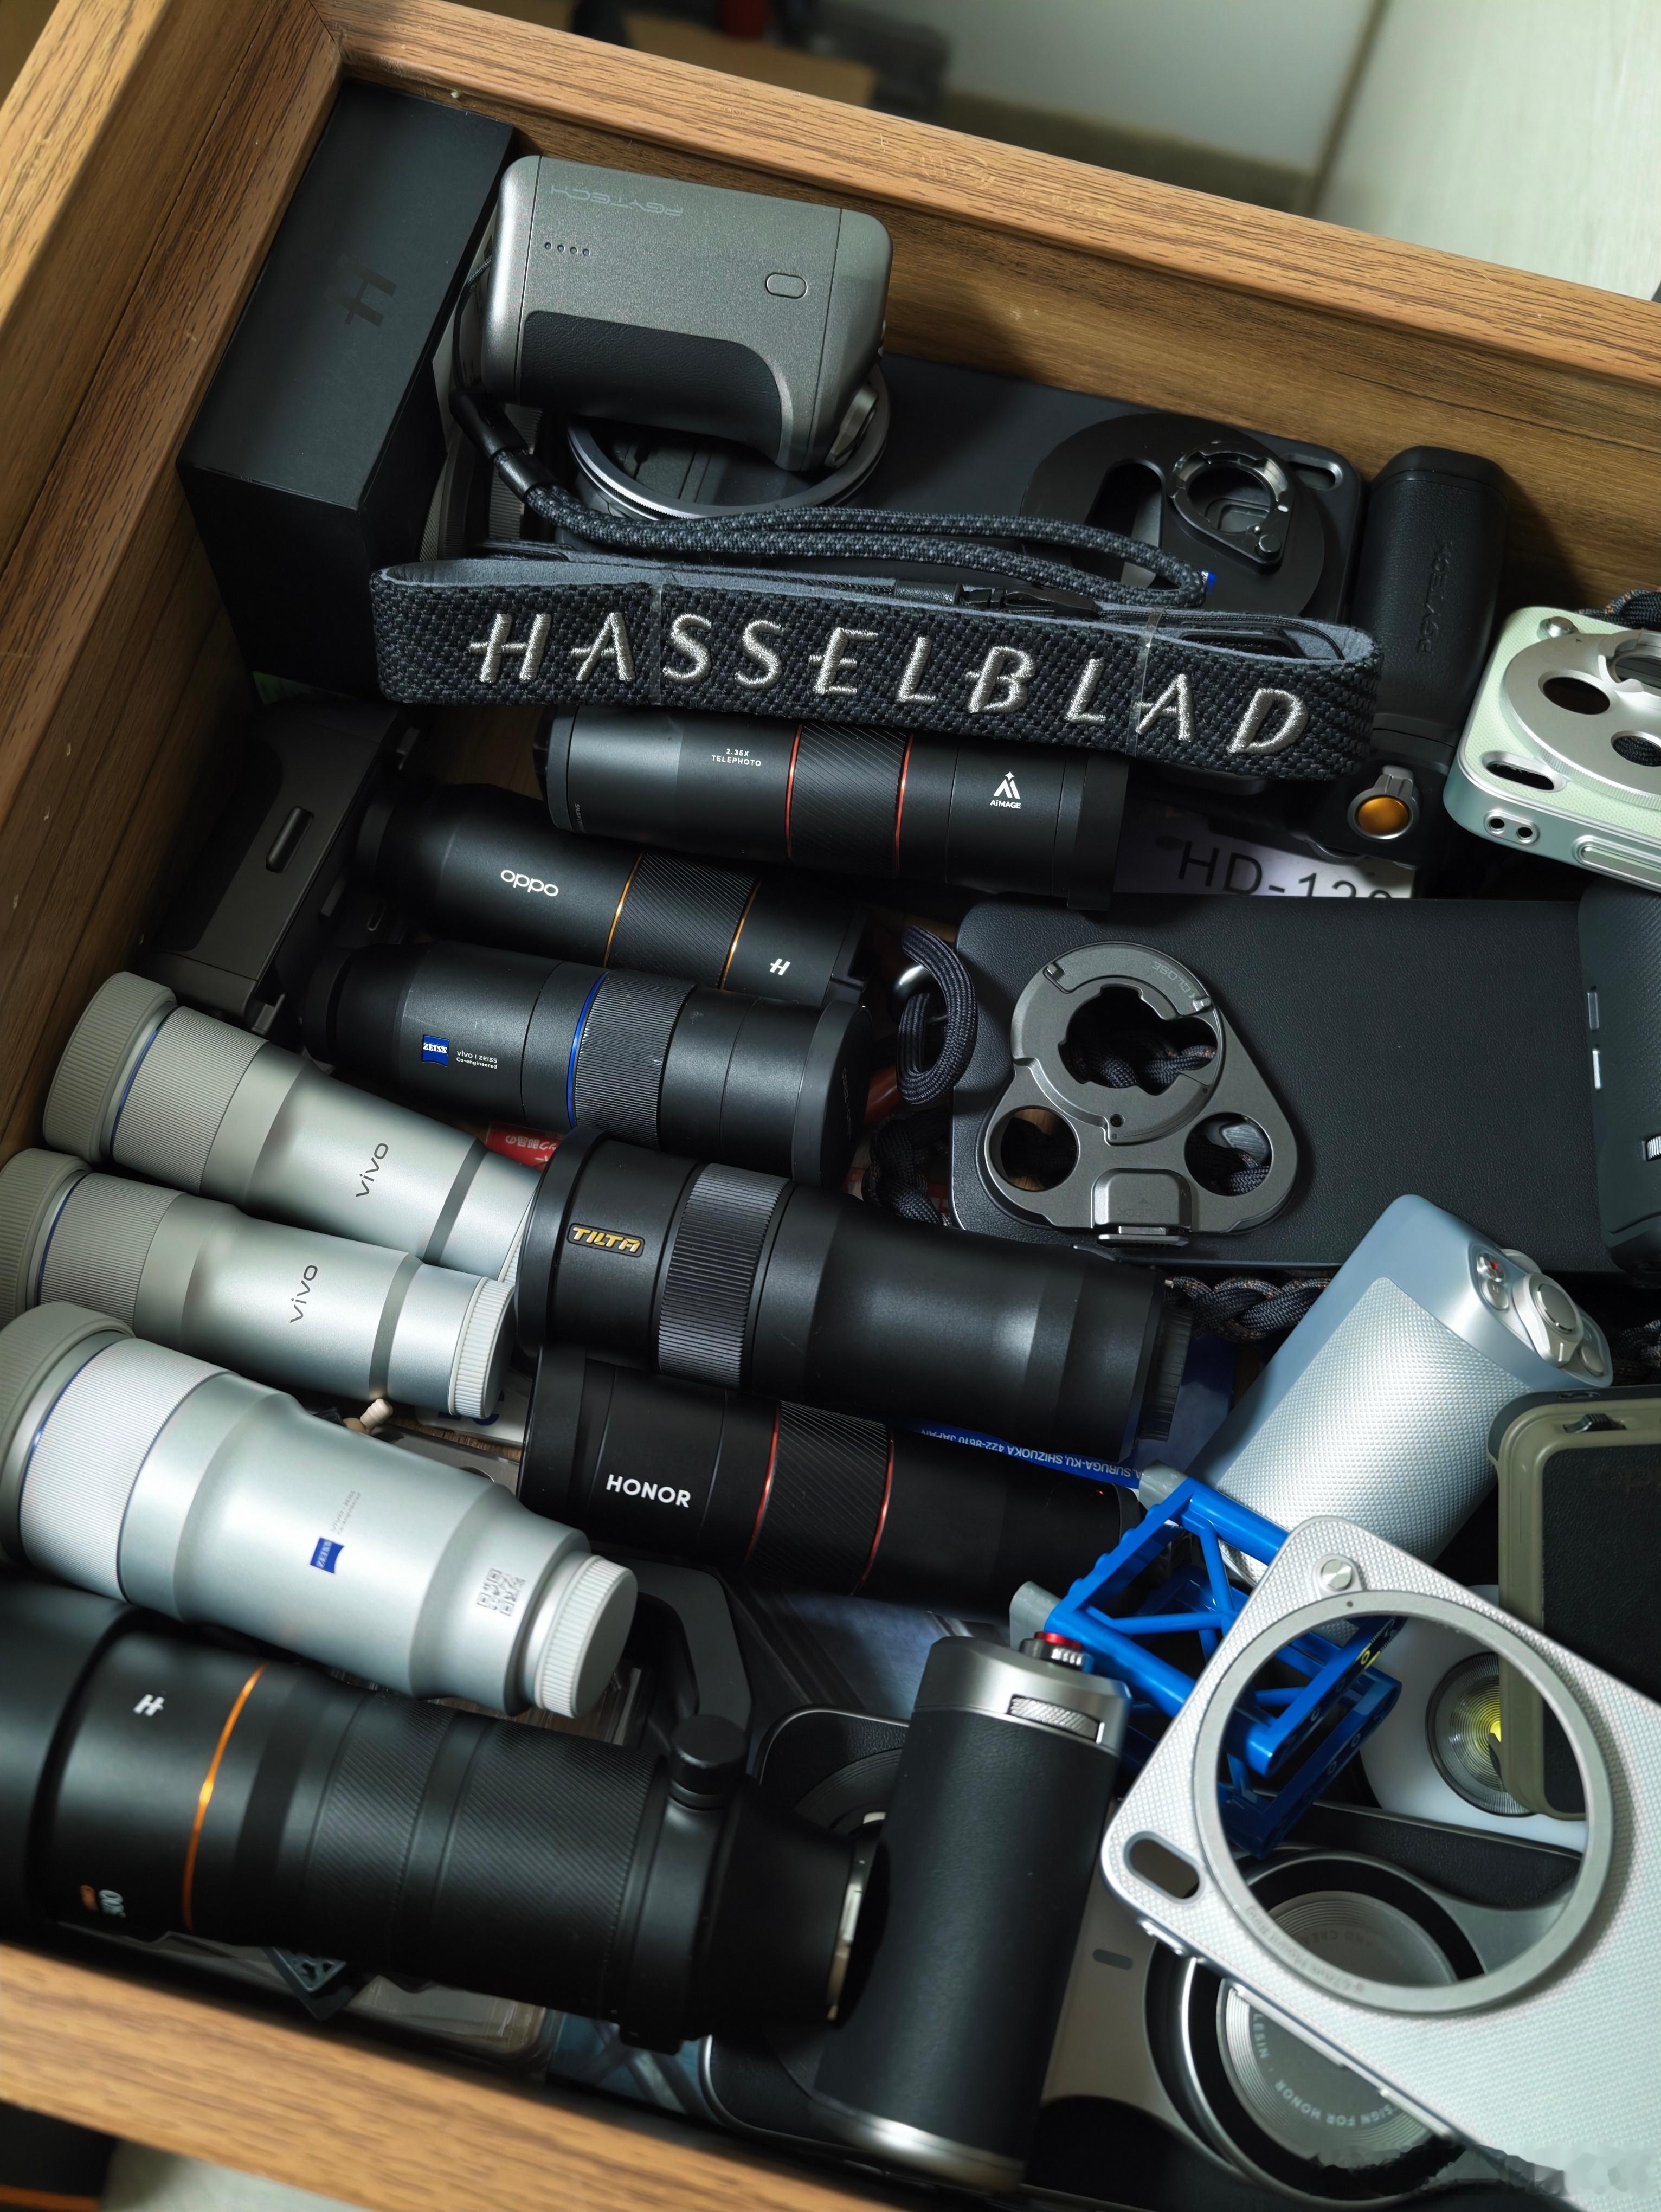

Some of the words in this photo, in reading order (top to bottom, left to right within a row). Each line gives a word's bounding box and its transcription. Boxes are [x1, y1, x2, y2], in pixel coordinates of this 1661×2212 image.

[549, 187, 683, 217] PGYTECH
[468, 611, 1310, 755] HASSELBLAD
[711, 754, 762, 767] TELEPHOTO
[725, 747, 750, 758] 2.35X
[500, 869, 559, 898] oppo
[1178, 841, 1392, 898] HD-1
[1151, 960, 1194, 998] CLOSE
[423, 1042, 448, 1054] ZEISS
[456, 1050, 473, 1059] vivo
[478, 1054, 498, 1064] ZEISS
[456, 1057, 498, 1070] Co-engineered
[355, 1142, 389, 1198] vivo
[572, 1227, 641, 1254] TILTA
[290, 1264, 319, 1323] vivo
[1007, 1444, 1064, 1465] SHIZUOKA
[1064, 1454, 1131, 1478] SURUGA-KU,
[606, 1474, 691, 1508] HONOR
[1275, 2079, 1322, 2121] HONOR
[1326, 2112, 1356, 2127] FOR
